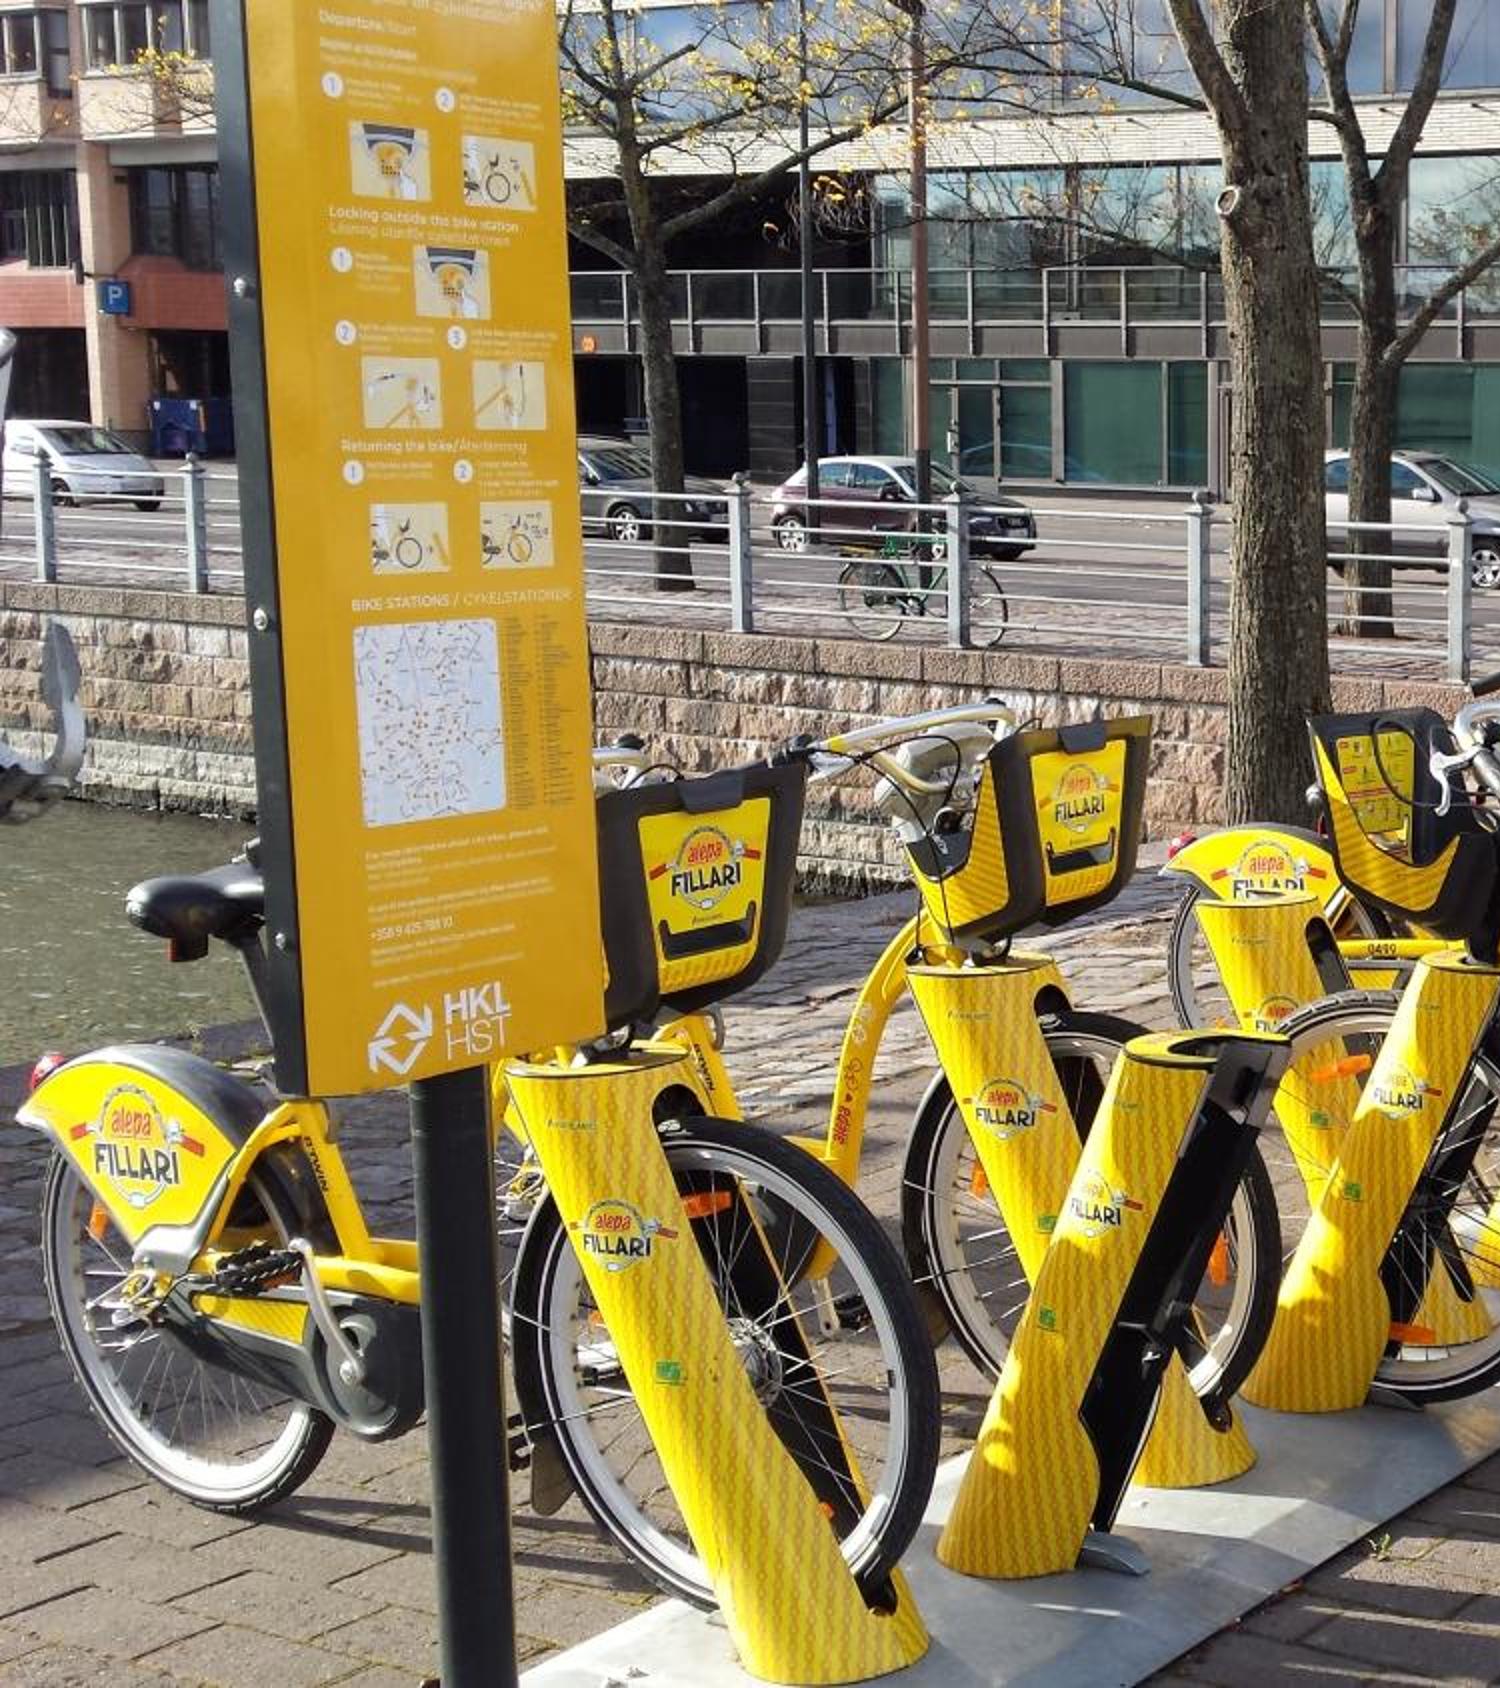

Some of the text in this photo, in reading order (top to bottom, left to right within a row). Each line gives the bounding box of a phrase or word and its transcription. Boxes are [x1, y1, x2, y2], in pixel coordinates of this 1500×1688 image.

[107, 285, 122, 305] P
[1055, 793, 1105, 823] FILLARI
[671, 861, 741, 896] FILLARI
[444, 981, 511, 1024] HKL
[446, 1013, 512, 1060] HST
[111, 1105, 152, 1138] alepa
[976, 1107, 1036, 1127] FILLARI
[94, 1142, 180, 1185] FILLARI
[583, 1233, 651, 1257] FILLARI
